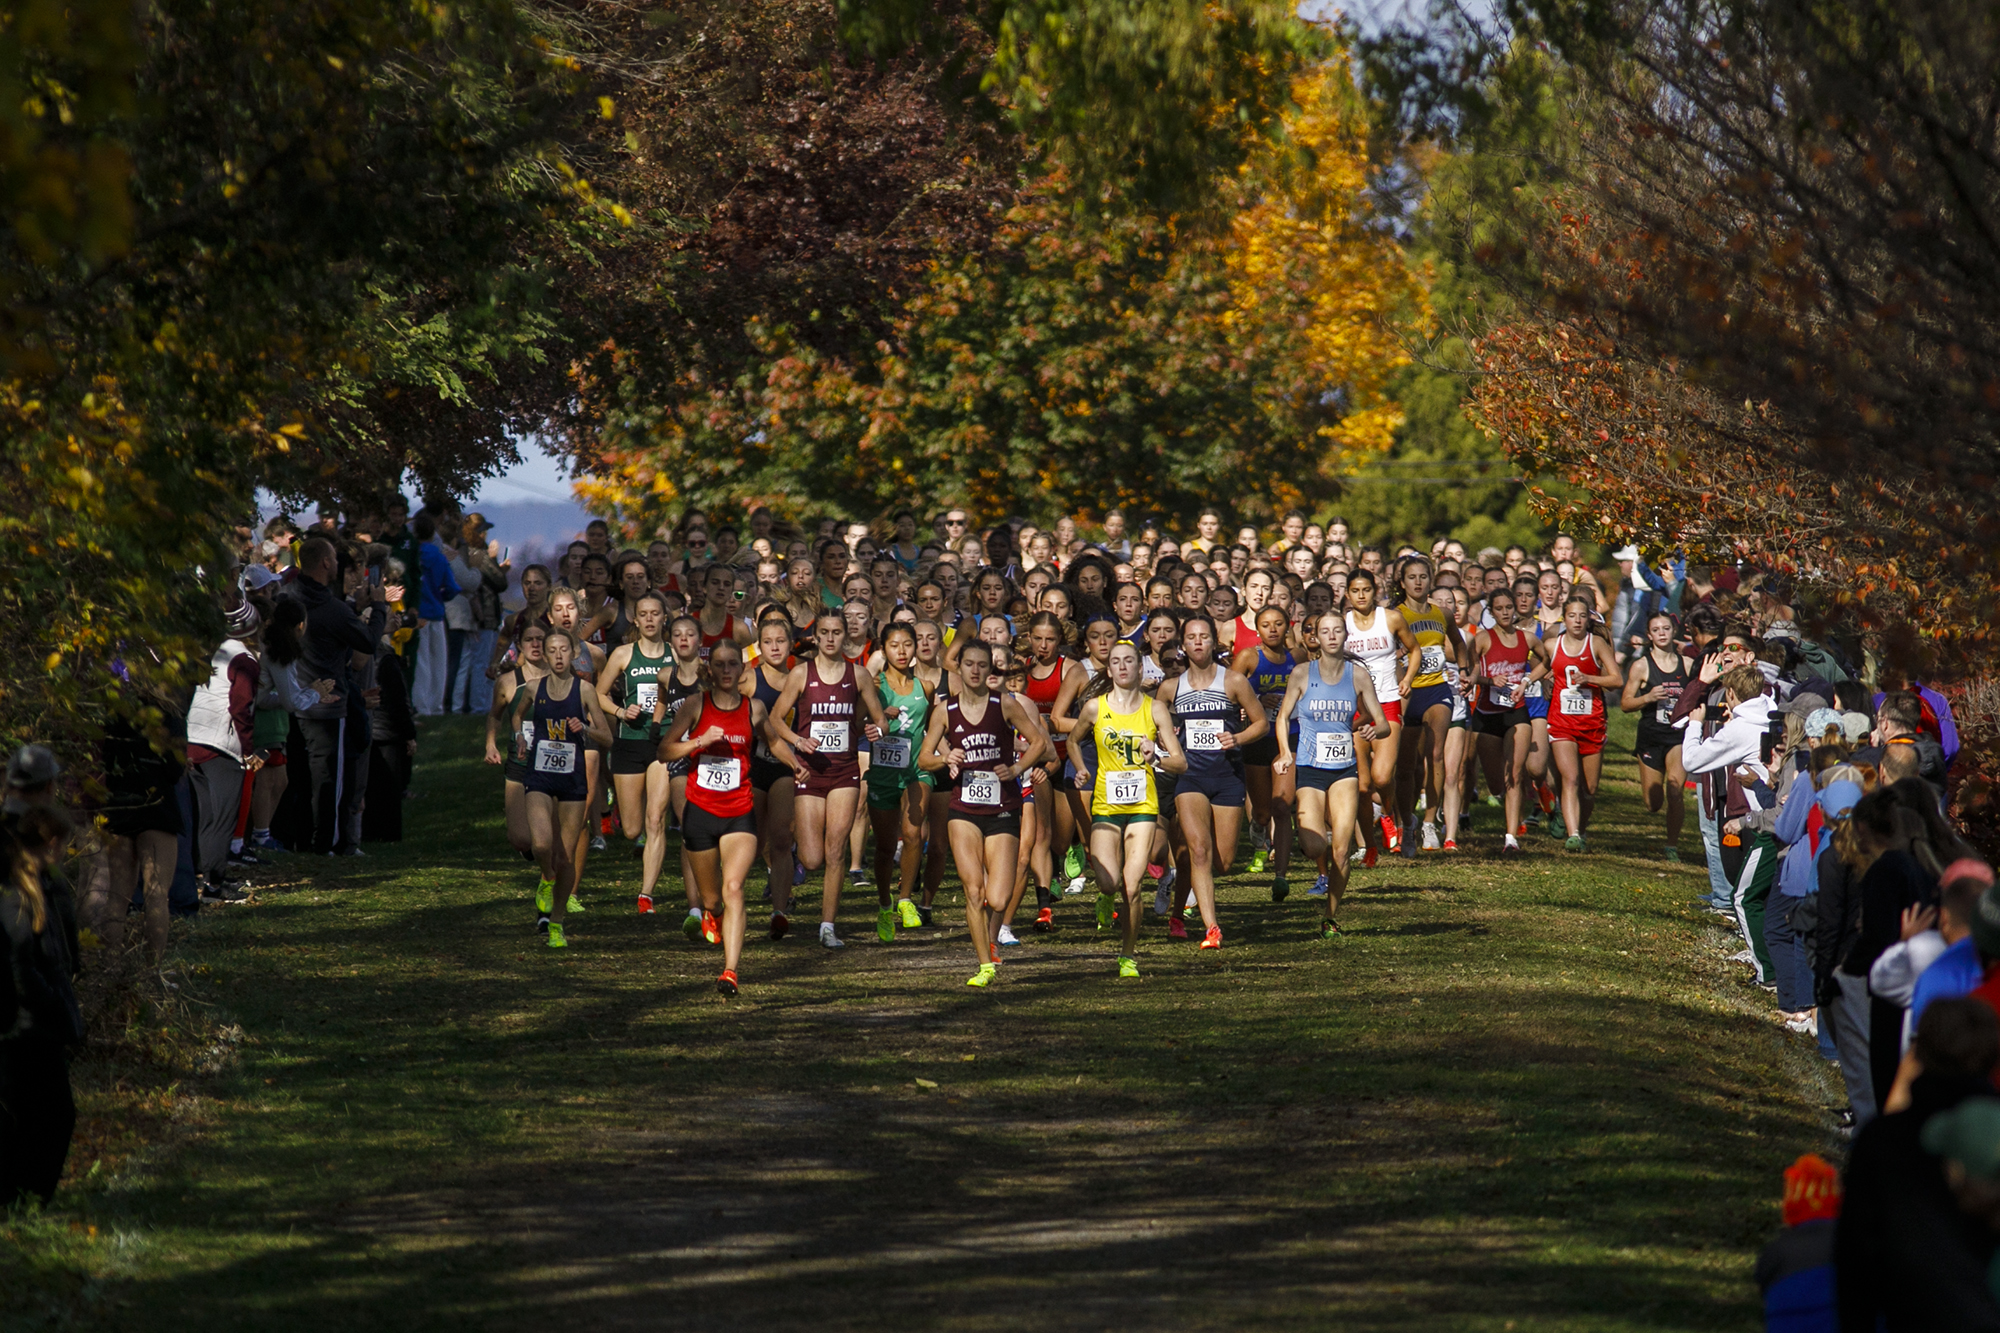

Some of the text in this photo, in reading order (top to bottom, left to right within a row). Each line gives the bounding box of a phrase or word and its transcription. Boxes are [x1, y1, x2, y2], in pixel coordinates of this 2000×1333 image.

[1367, 635, 1389, 650] DUBLIN
[811, 702, 854, 715] ALTOONA
[1176, 701, 1227, 714] DALLASTOWN
[1309, 699, 1352, 712] NORTH
[1567, 699, 1585, 710] 718
[1313, 711, 1348, 722] PENN
[546, 718, 568, 741] W
[818, 734, 841, 747] 705
[961, 732, 997, 750] STATE
[1193, 732, 1215, 745] 588
[880, 748, 902, 763] 675
[1325, 745, 1346, 758] 764
[543, 753, 567, 768] 796
[707, 769, 731, 786] 793
[969, 784, 992, 799] 683
[1115, 784, 1139, 798] 617
